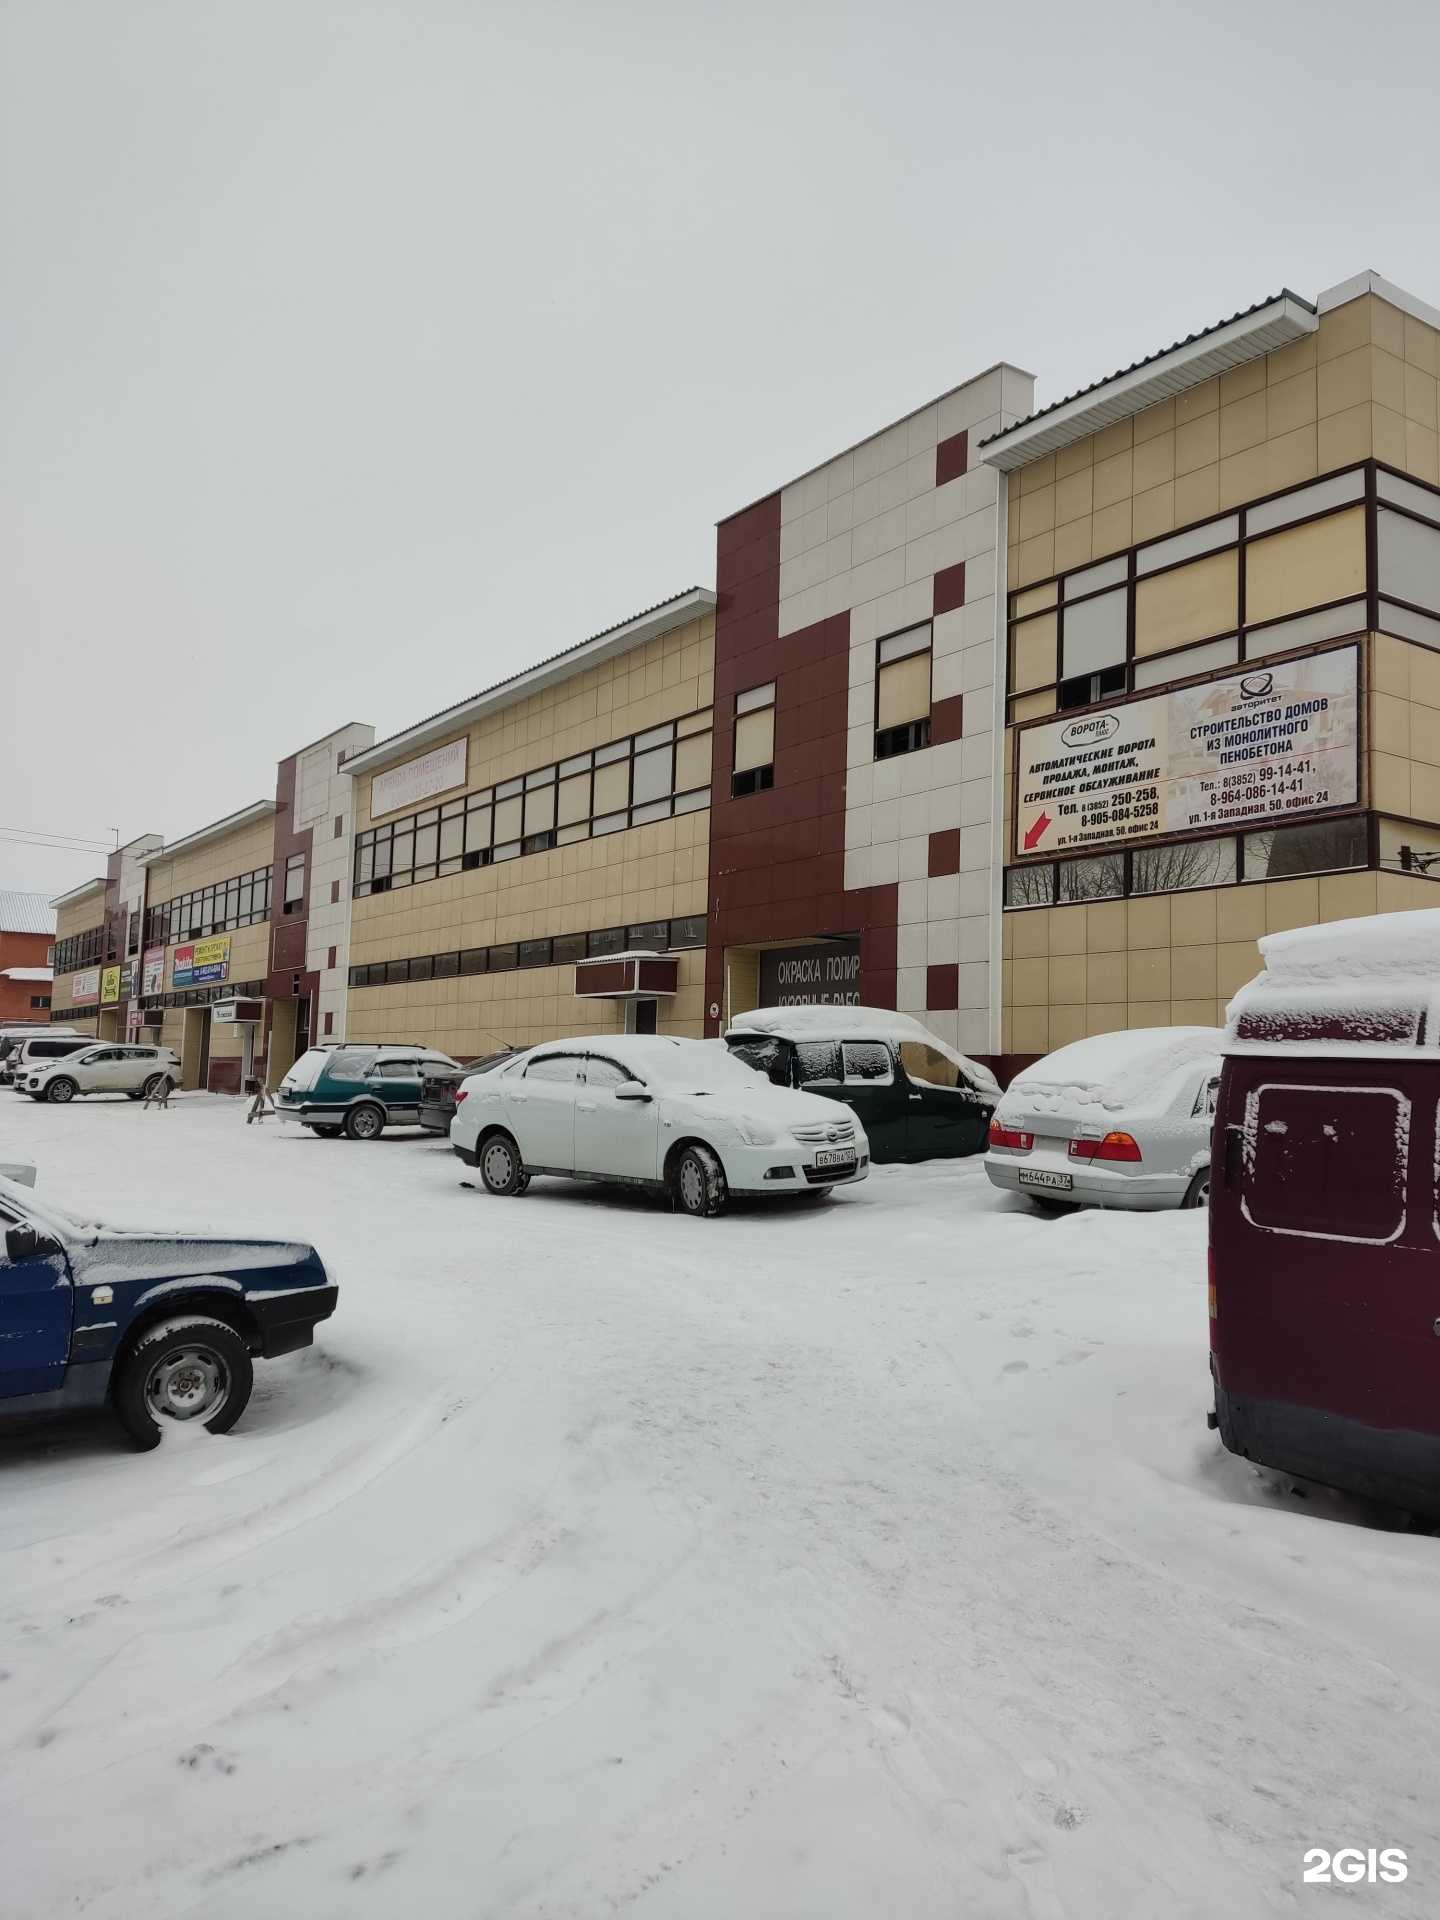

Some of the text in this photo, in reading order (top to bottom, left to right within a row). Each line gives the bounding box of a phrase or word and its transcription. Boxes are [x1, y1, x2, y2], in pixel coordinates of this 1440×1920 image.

[1230, 695, 1282, 712] авторитет
[1190, 698, 1329, 739] СТРОИТЕЛЬСТВО ДОМОВ
[1207, 719, 1309, 751] ИЗ МОНОЛИТНОГО
[1029, 738, 1156, 774] АВТОМАТИЧЕСКИЕ ВОРОТА
[1220, 740, 1293, 765] ПЕНОБЕТОНА
[1043, 767, 1090, 785] ПРОДАЖА,
[1259, 760, 1316, 781] 99-14-41,
[1024, 768, 1160, 803] СЕРВИСНОЕ ОБСЛУЖИВАНИЕ
[1210, 778, 1304, 806] 8-964-086-14-41
[1058, 804, 1078, 816] Тел.
[1081, 802, 1159, 827] 8-905-084-5258
[1188, 812, 1201, 825] ул.
[1203, 809, 1216, 821] 1-я
[1286, 794, 1314, 809] офис
[1316, 791, 1329, 803] 24
[1057, 836, 1067, 846] ул.
[1128, 823, 1149, 836] офис
[1150, 820, 1159, 830] 24
[778, 955, 861, 985] ОКРАСКА ПОЛИР
